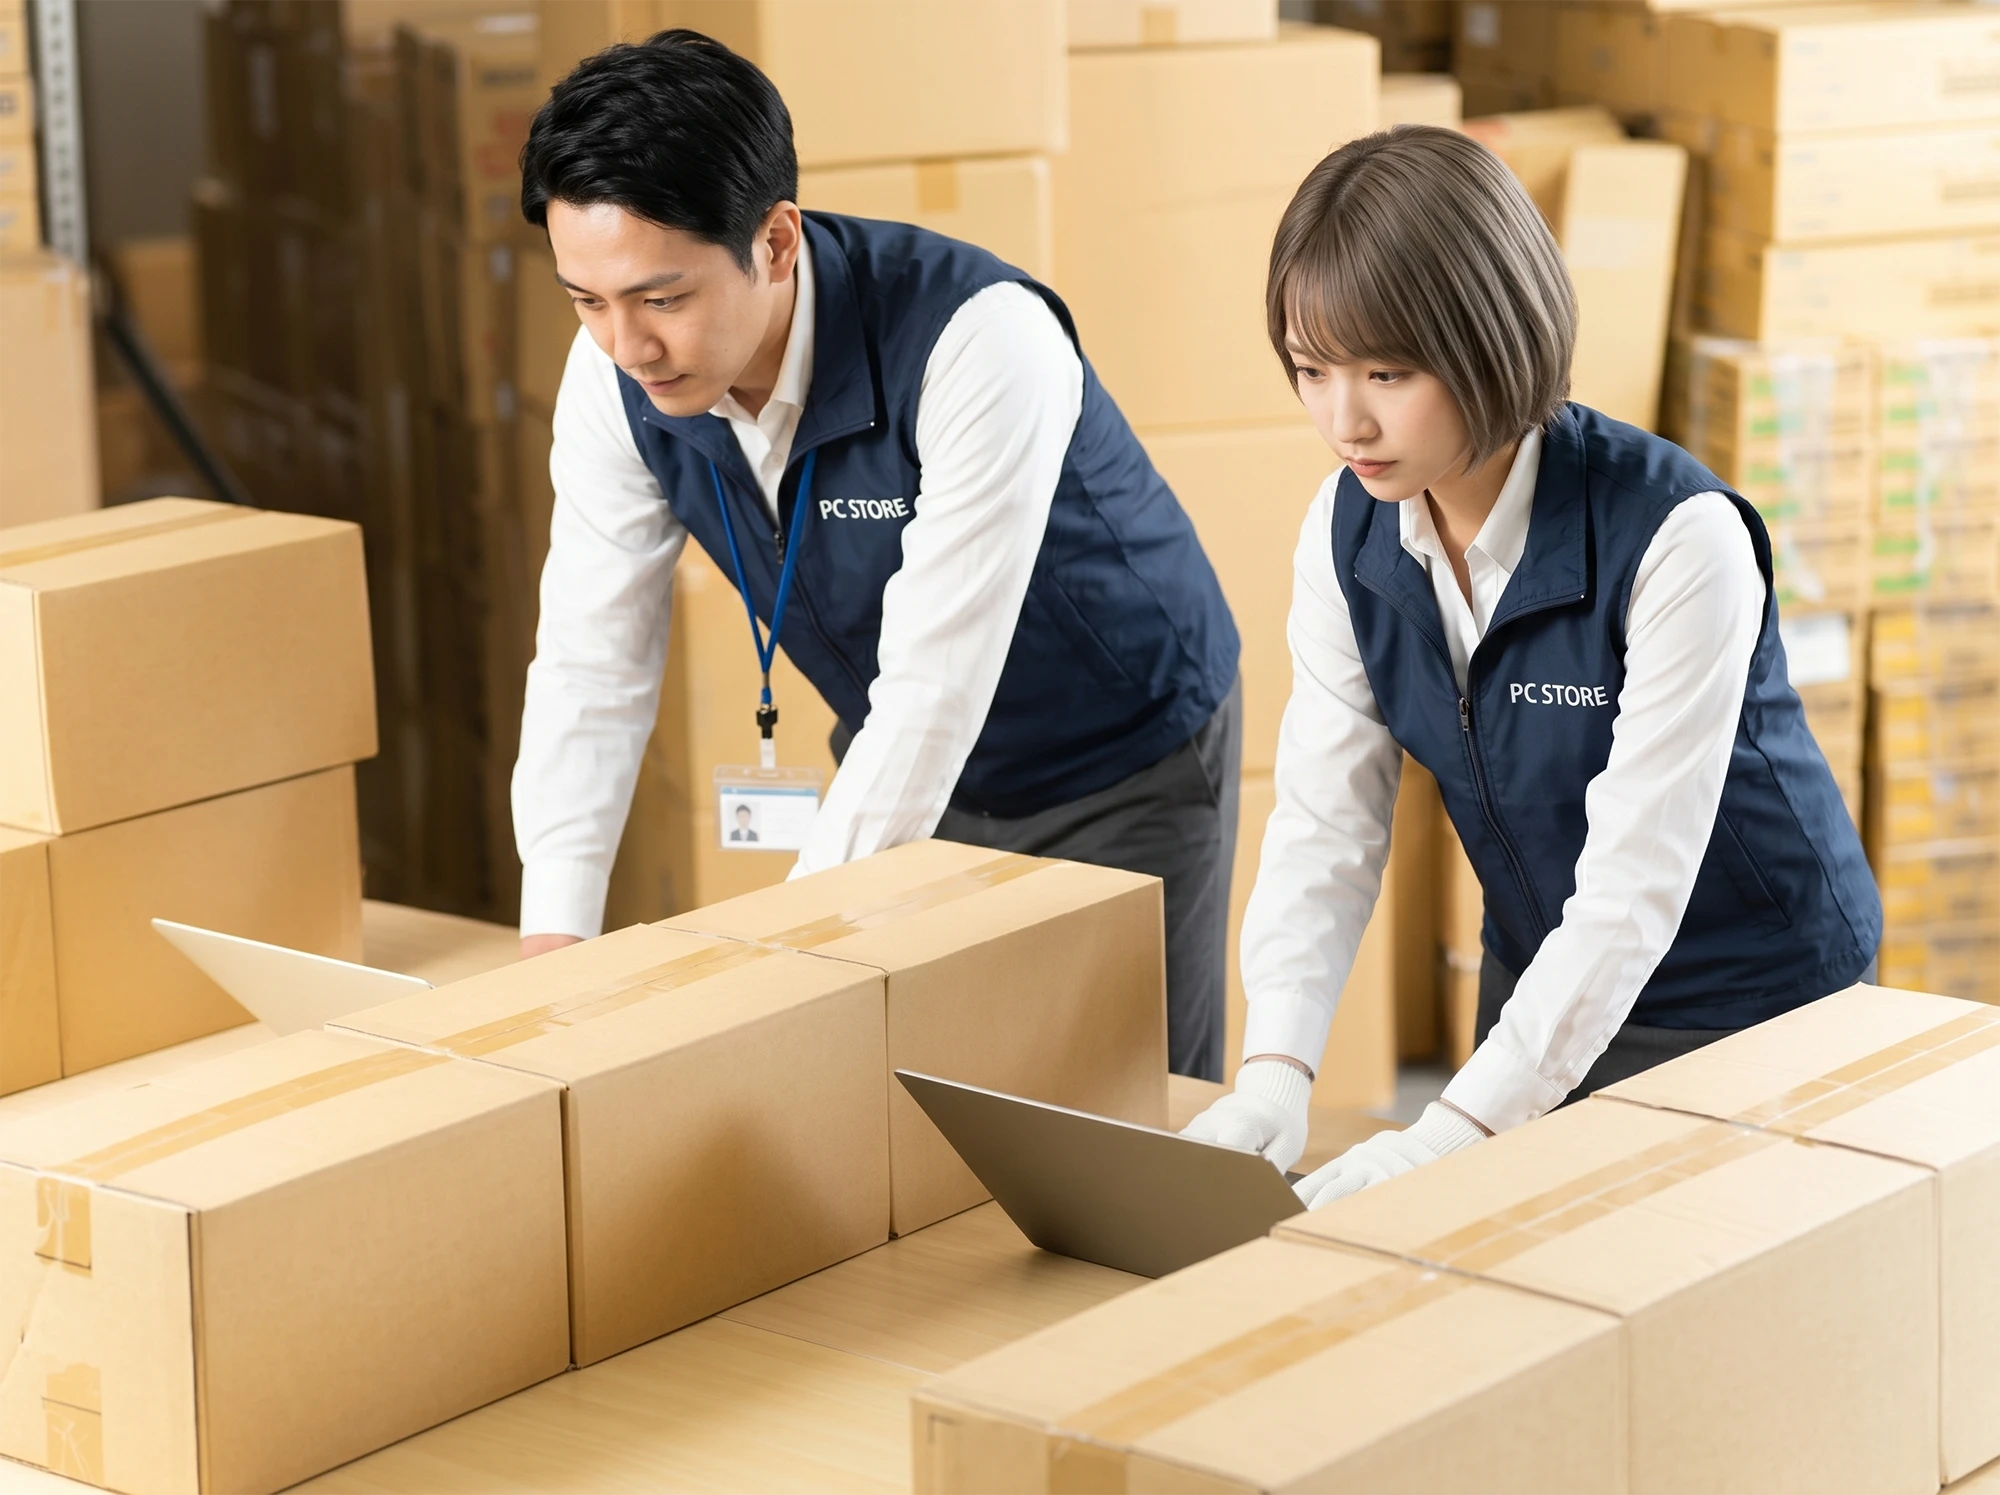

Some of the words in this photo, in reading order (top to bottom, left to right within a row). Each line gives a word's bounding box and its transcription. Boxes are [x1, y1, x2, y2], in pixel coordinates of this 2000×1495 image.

[819, 498, 847, 520] PC
[848, 497, 910, 520] STORE
[1509, 682, 1538, 704] PC
[1541, 683, 1609, 707] STORE
